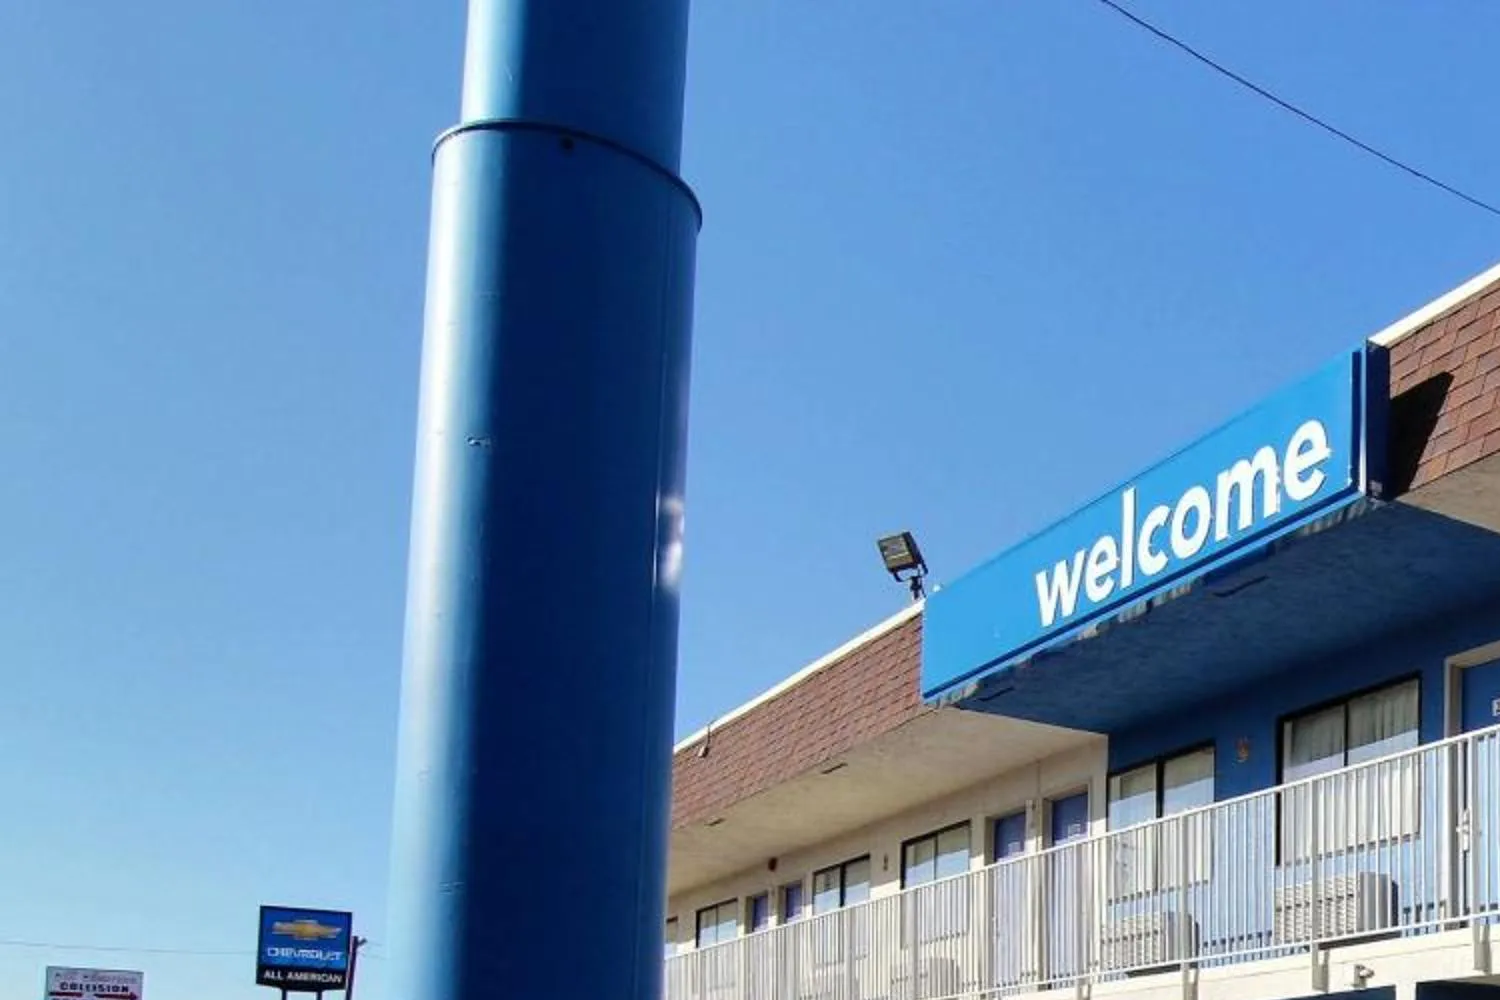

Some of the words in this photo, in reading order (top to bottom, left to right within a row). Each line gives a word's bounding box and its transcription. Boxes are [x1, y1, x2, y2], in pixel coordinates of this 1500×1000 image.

[1034, 418, 1332, 628] welcome
[267, 946, 343, 961] CHEVROLET
[263, 969, 284, 980] ALL
[286, 971, 343, 983] AMERICAN
[60, 981, 129, 993] COLLISION
